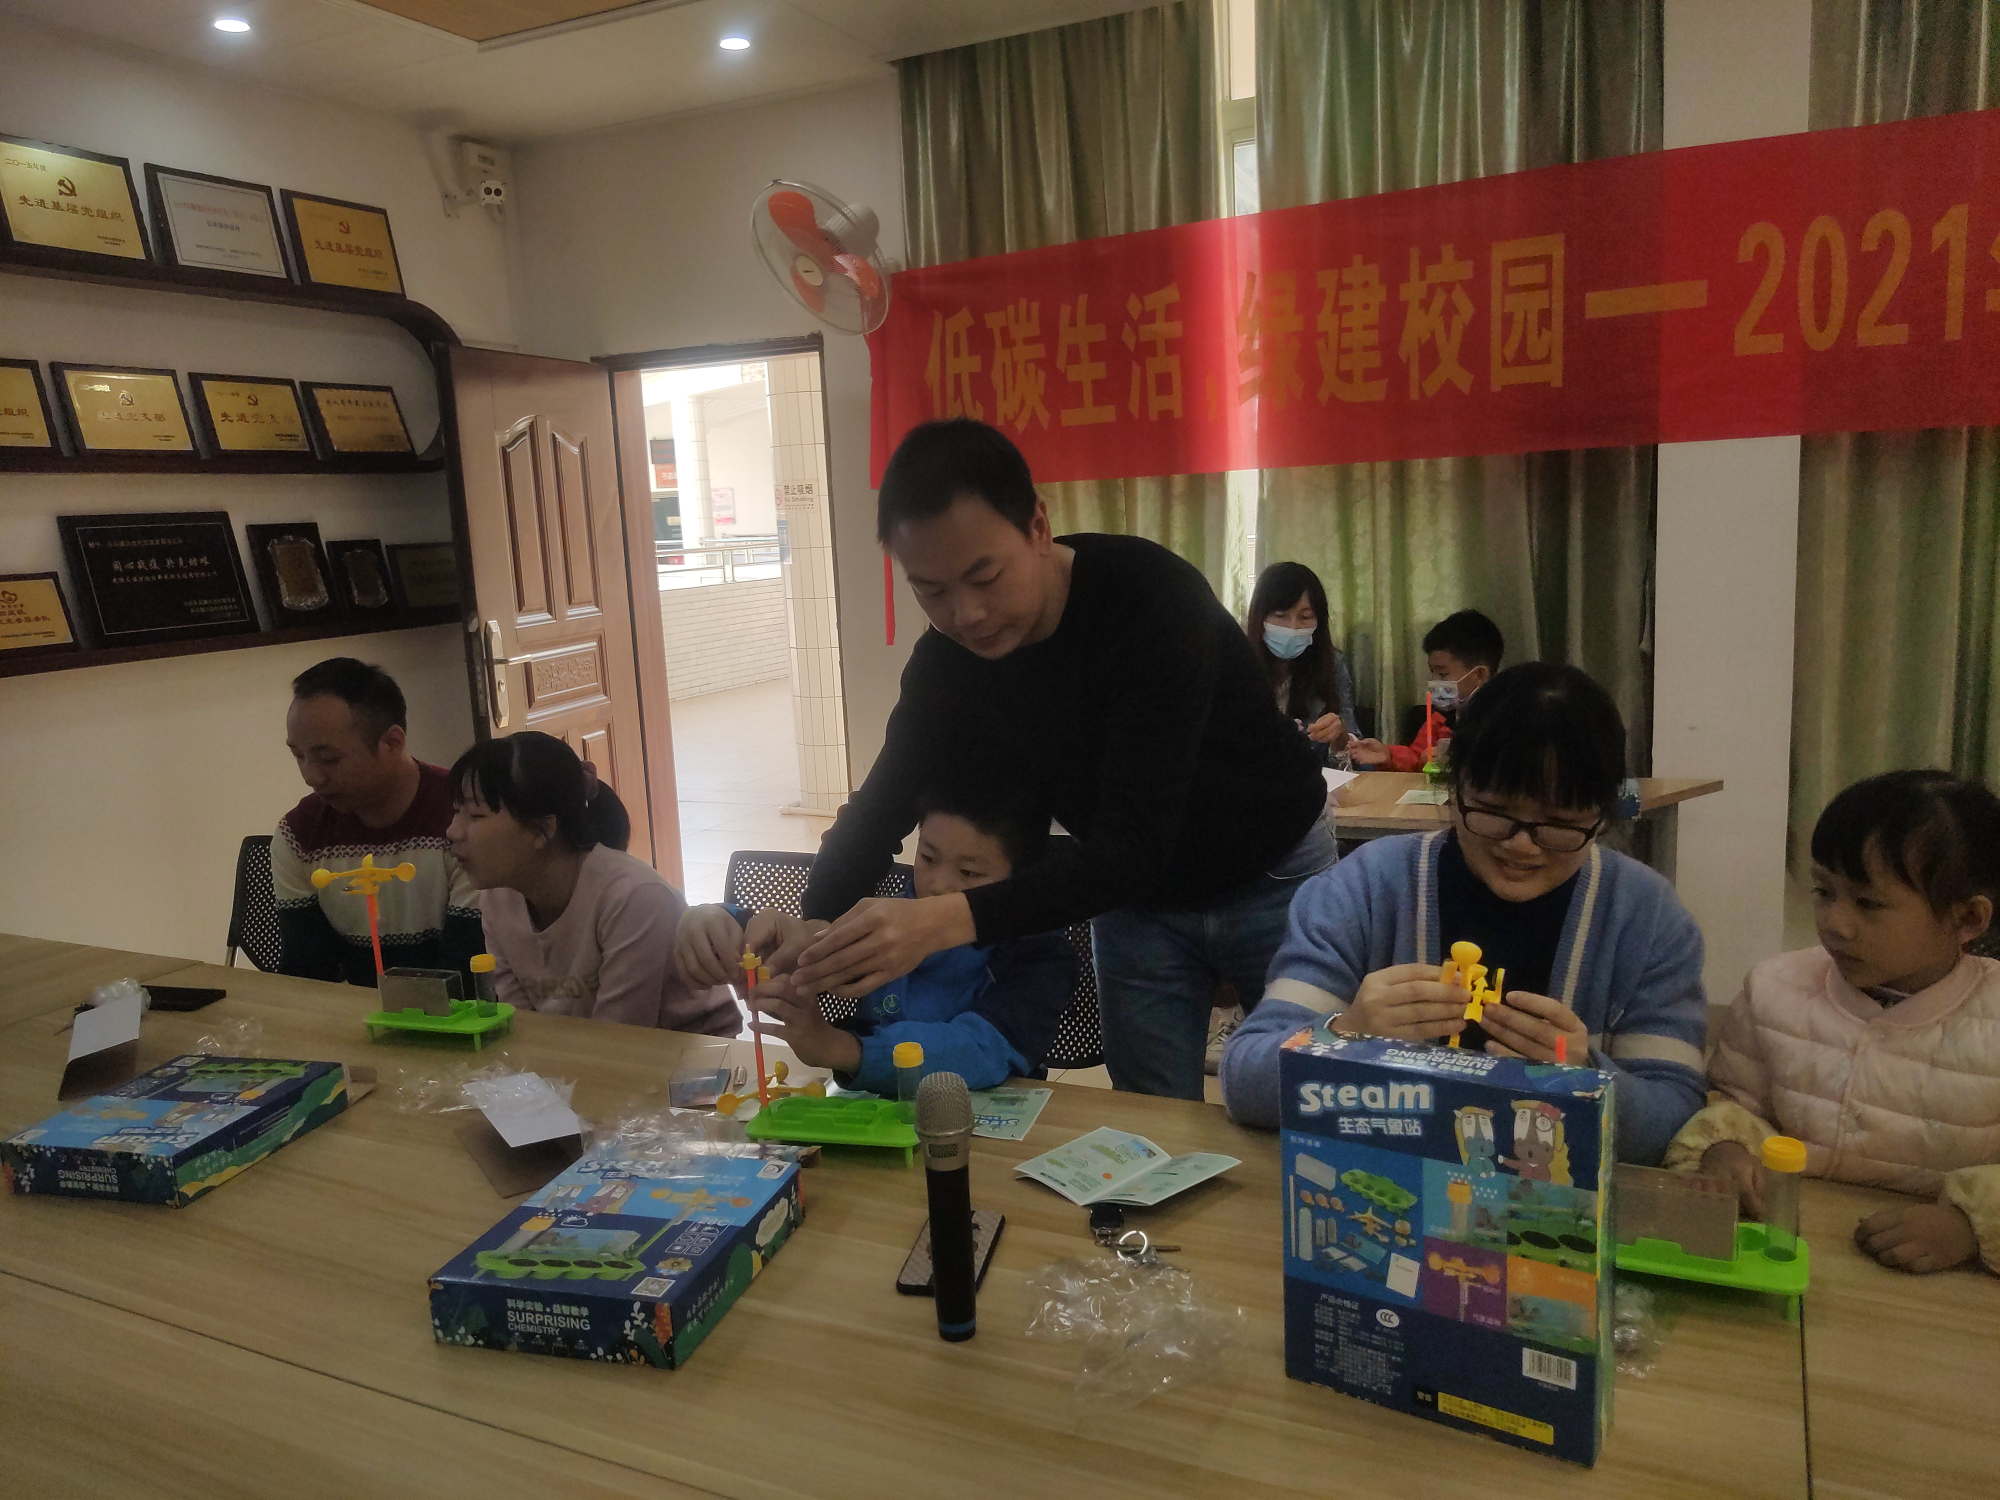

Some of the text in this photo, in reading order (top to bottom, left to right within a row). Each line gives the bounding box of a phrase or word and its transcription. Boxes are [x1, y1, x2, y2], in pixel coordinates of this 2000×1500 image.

[19, 195, 124, 222] 先进基层党组织
[783, 483, 813, 496] 禁止吸烟
[1385, 1048, 1495, 1070] SURPRISING
[1299, 1081, 1431, 1113] Steam
[1338, 1117, 1422, 1136] 生态气象站
[57, 1169, 118, 1184] SURPRISING
[79, 1165, 117, 1174] CHEMISTRY
[506, 1310, 591, 1331] SURPRISING
[507, 1322, 561, 1336] CHEMISTRY
